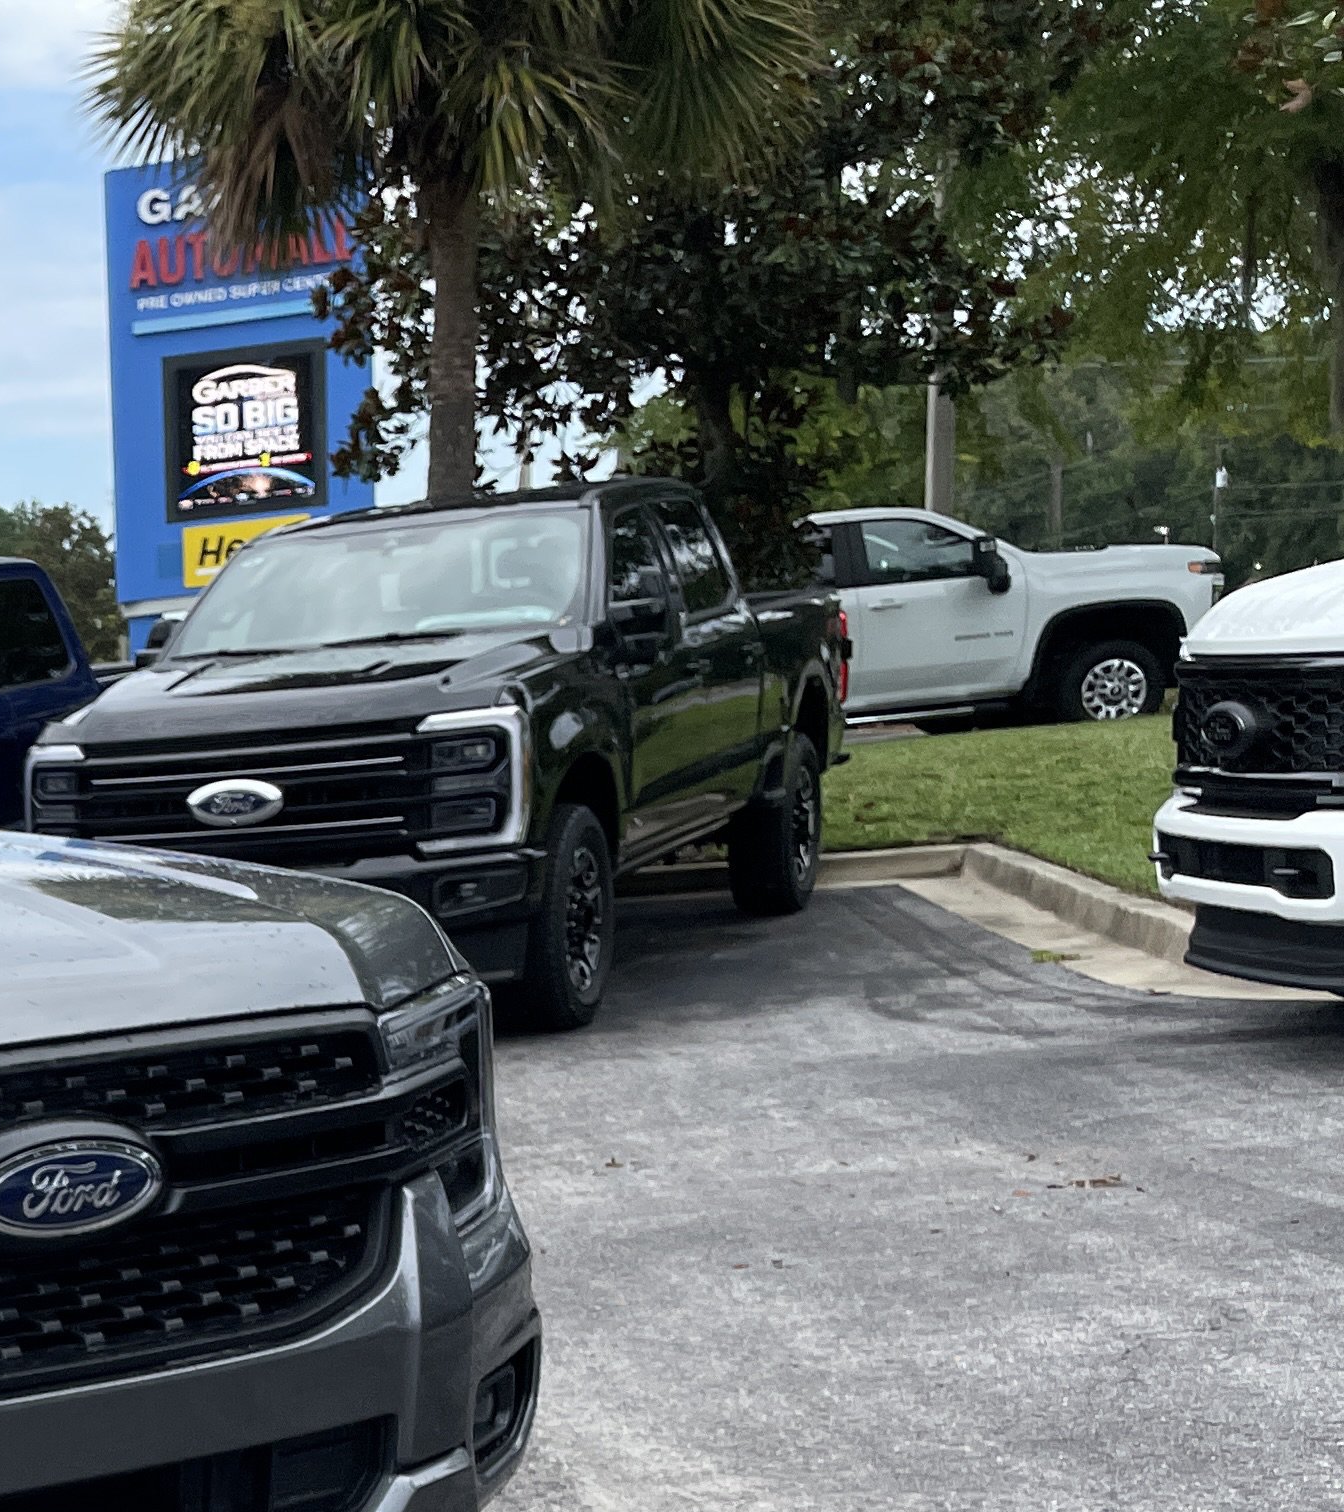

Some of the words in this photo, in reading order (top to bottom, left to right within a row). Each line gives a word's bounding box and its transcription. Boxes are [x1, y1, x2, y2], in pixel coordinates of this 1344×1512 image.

[192, 402, 239, 436] SO
[243, 397, 299, 431] BIG
[193, 440, 243, 461] FROM
[244, 434, 300, 456] SPACE
[210, 792, 256, 815] Ford
[21, 1160, 121, 1220] Ford
